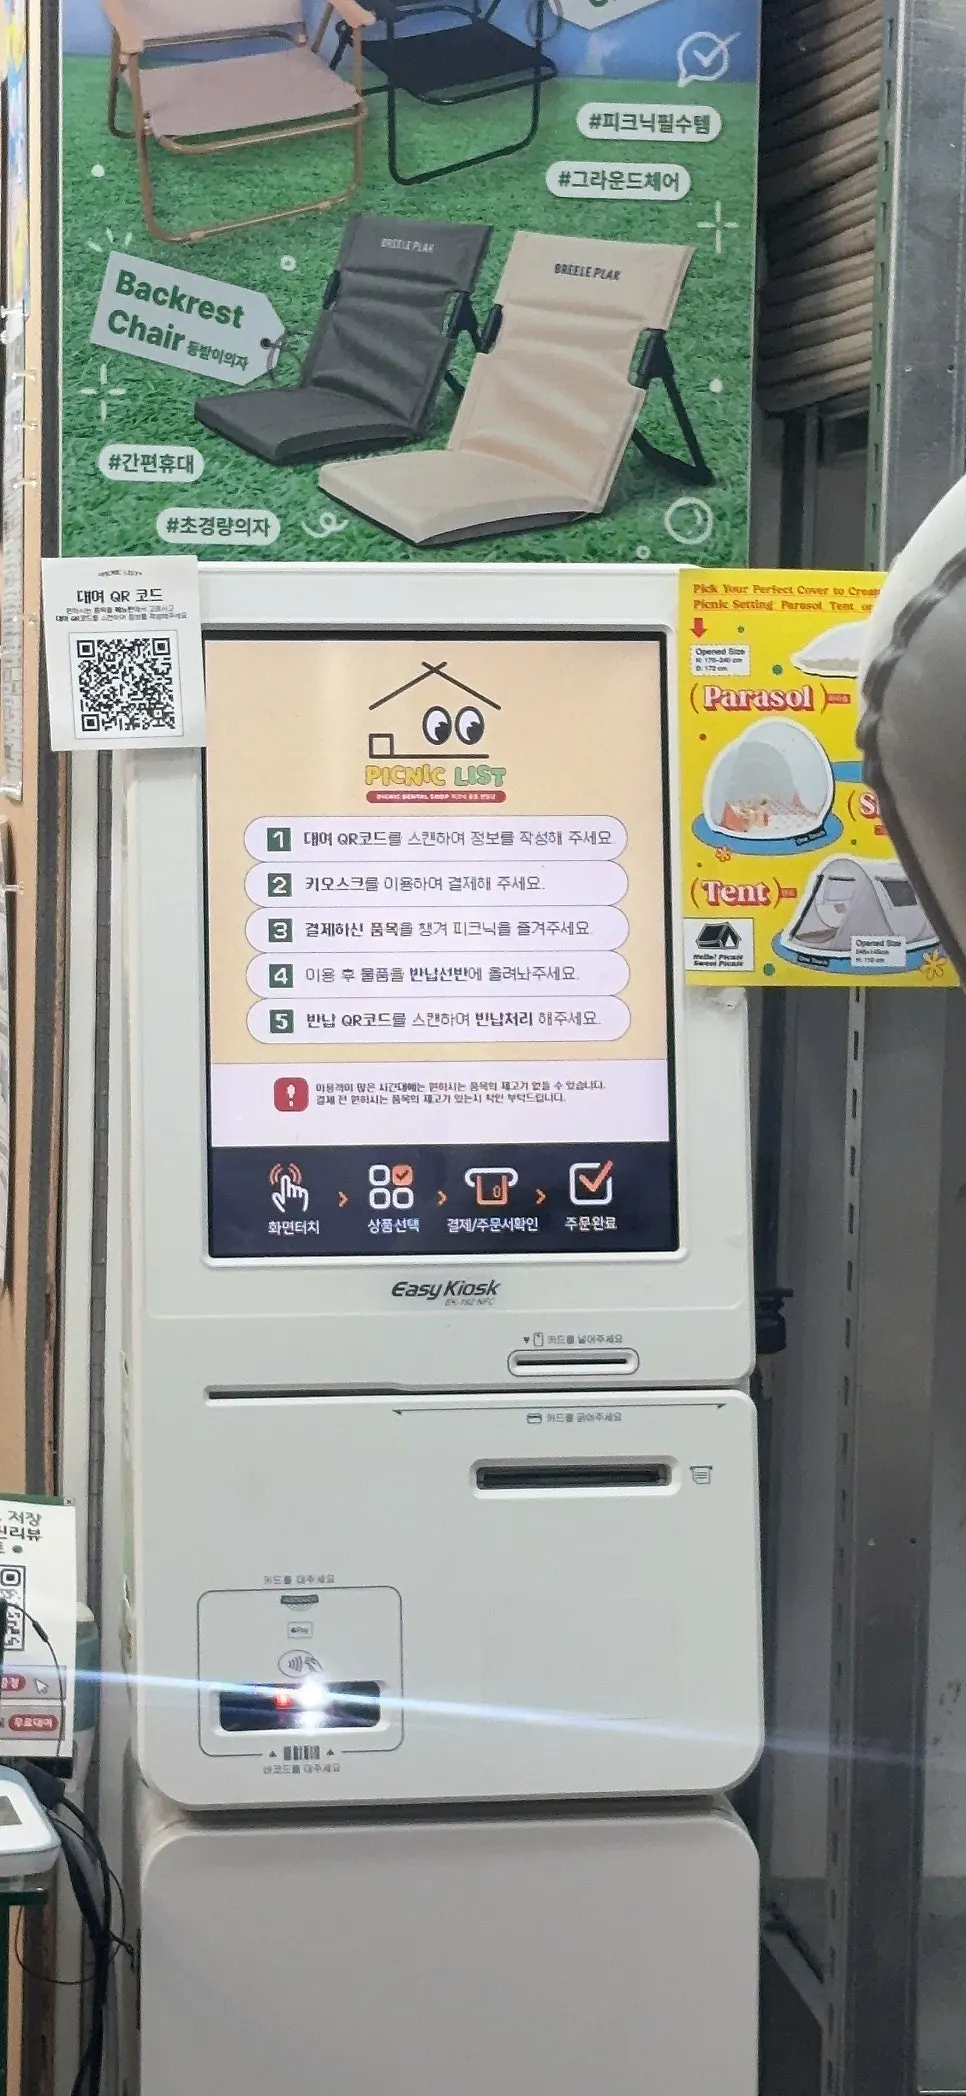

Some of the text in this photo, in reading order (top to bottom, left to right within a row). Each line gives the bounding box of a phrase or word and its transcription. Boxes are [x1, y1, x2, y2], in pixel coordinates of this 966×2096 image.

[589, 112, 710, 134] #피크닉필수템
[558, 170, 679, 192] #그라운드체어
[554, 263, 620, 281] BREELE PLAK
[116, 269, 244, 329] Backrest
[108, 310, 248, 371] Chair 등받이의자
[109, 453, 194, 474] #간편휴대
[166, 516, 270, 537] #초경량의자
[76, 588, 164, 604] 대여 QR 코드
[693, 584, 718, 594] Pick
[723, 585, 748, 594] Your
[753, 584, 792, 595] Perfect
[797, 586, 829, 596] Cover
[833, 587, 845, 596] to
[693, 600, 728, 610] Picnic
[733, 600, 773, 611] Setting
[781, 600, 822, 610] Parasol
[830, 602, 854, 610] Tent
[696, 648, 745, 657] Opened Size
[365, 764, 506, 787] PICNIC LIST
[273, 831, 284, 848] 1
[304, 832, 332, 846] 대여
[338, 832, 402, 846] QR코드를
[408, 831, 465, 846] 스캔하여
[471, 831, 514, 846] 정보를
[520, 830, 562, 846] 작성해
[272, 876, 546, 894] 2 키오스크를 이용하여 결제해 주세요.
[273, 922, 288, 940] 3
[306, 922, 364, 937] 결제하신
[371, 922, 412, 936] 품목을
[419, 922, 448, 936] 챙겨
[454, 921, 512, 936] 피크닉을
[274, 968, 288, 985] 4
[306, 968, 335, 982] 이용
[342, 968, 356, 982] 후
[361, 968, 404, 982] 물품을
[410, 967, 482, 982] 반납선반에
[276, 1011, 601, 1030] 5 반납 QR코드를 스캔하여 반납처리 해주세요.
[268, 1216, 617, 1236] 화면터치 상품선택 결제/주문서확인 주문완료
[8, 1510, 42, 1526] 저장
